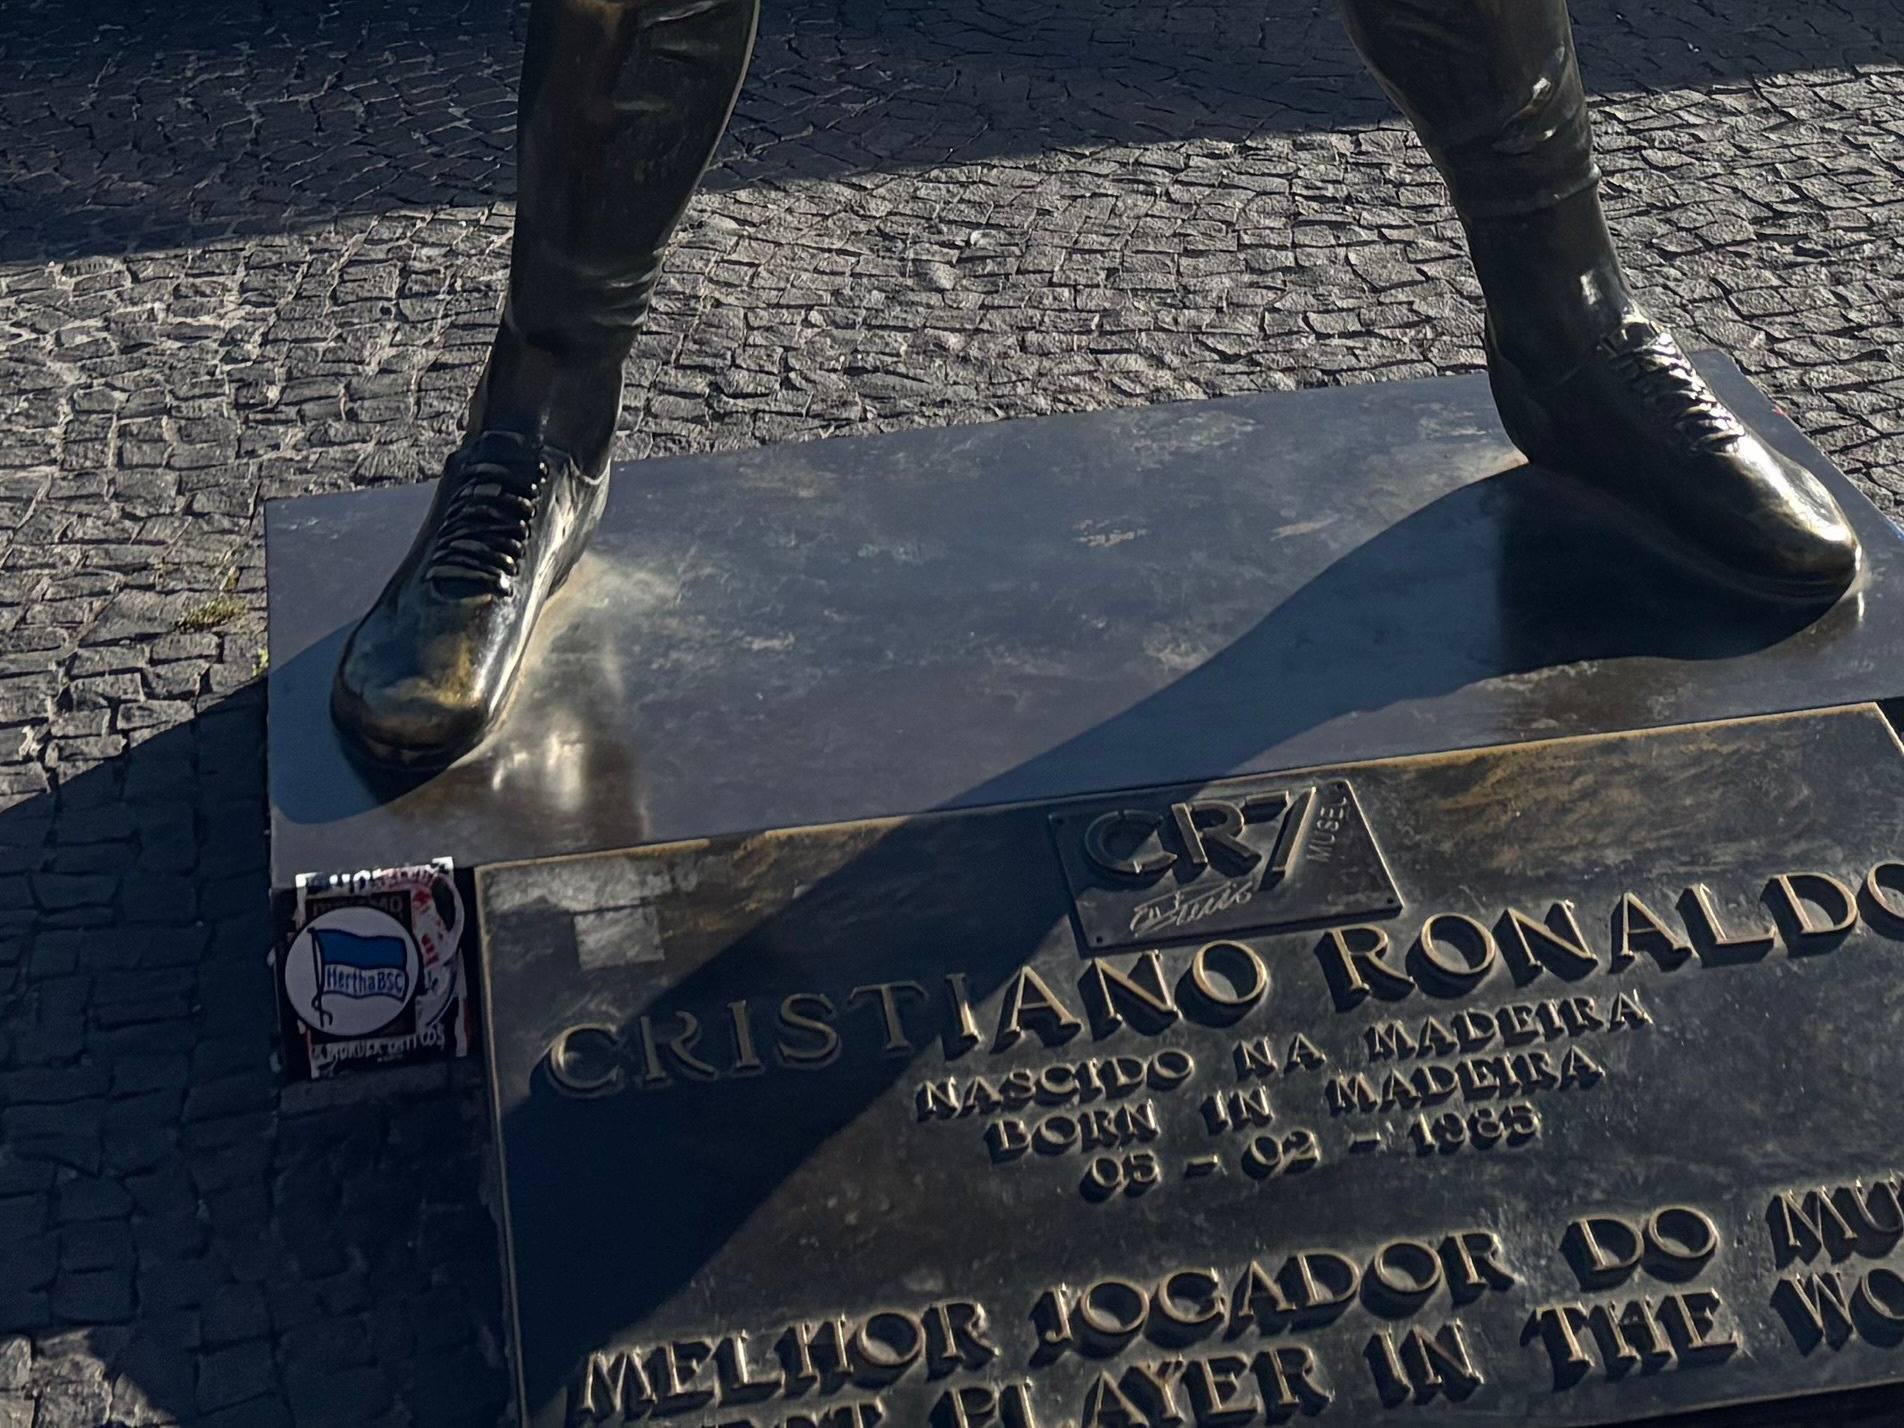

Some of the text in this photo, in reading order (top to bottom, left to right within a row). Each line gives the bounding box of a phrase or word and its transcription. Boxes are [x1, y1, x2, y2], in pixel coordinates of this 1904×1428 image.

[1083, 787, 1318, 876] CR7
[546, 939, 1273, 1094] CRISTIANO
[918, 988, 1654, 1120] NASCIDO NA MADEIRA
[989, 1046, 1606, 1157] BORN IN MADEIRA
[1084, 1150, 1162, 1196] 05
[1244, 1127, 1323, 1176] 02
[1410, 1101, 1543, 1154] 1985
[578, 1300, 998, 1416] MELHOR
[1034, 1228, 1514, 1350] JOGADOR
[1562, 1204, 1719, 1278] DO
[1366, 1319, 1486, 1396] IN
[1530, 1286, 1740, 1376] THE
